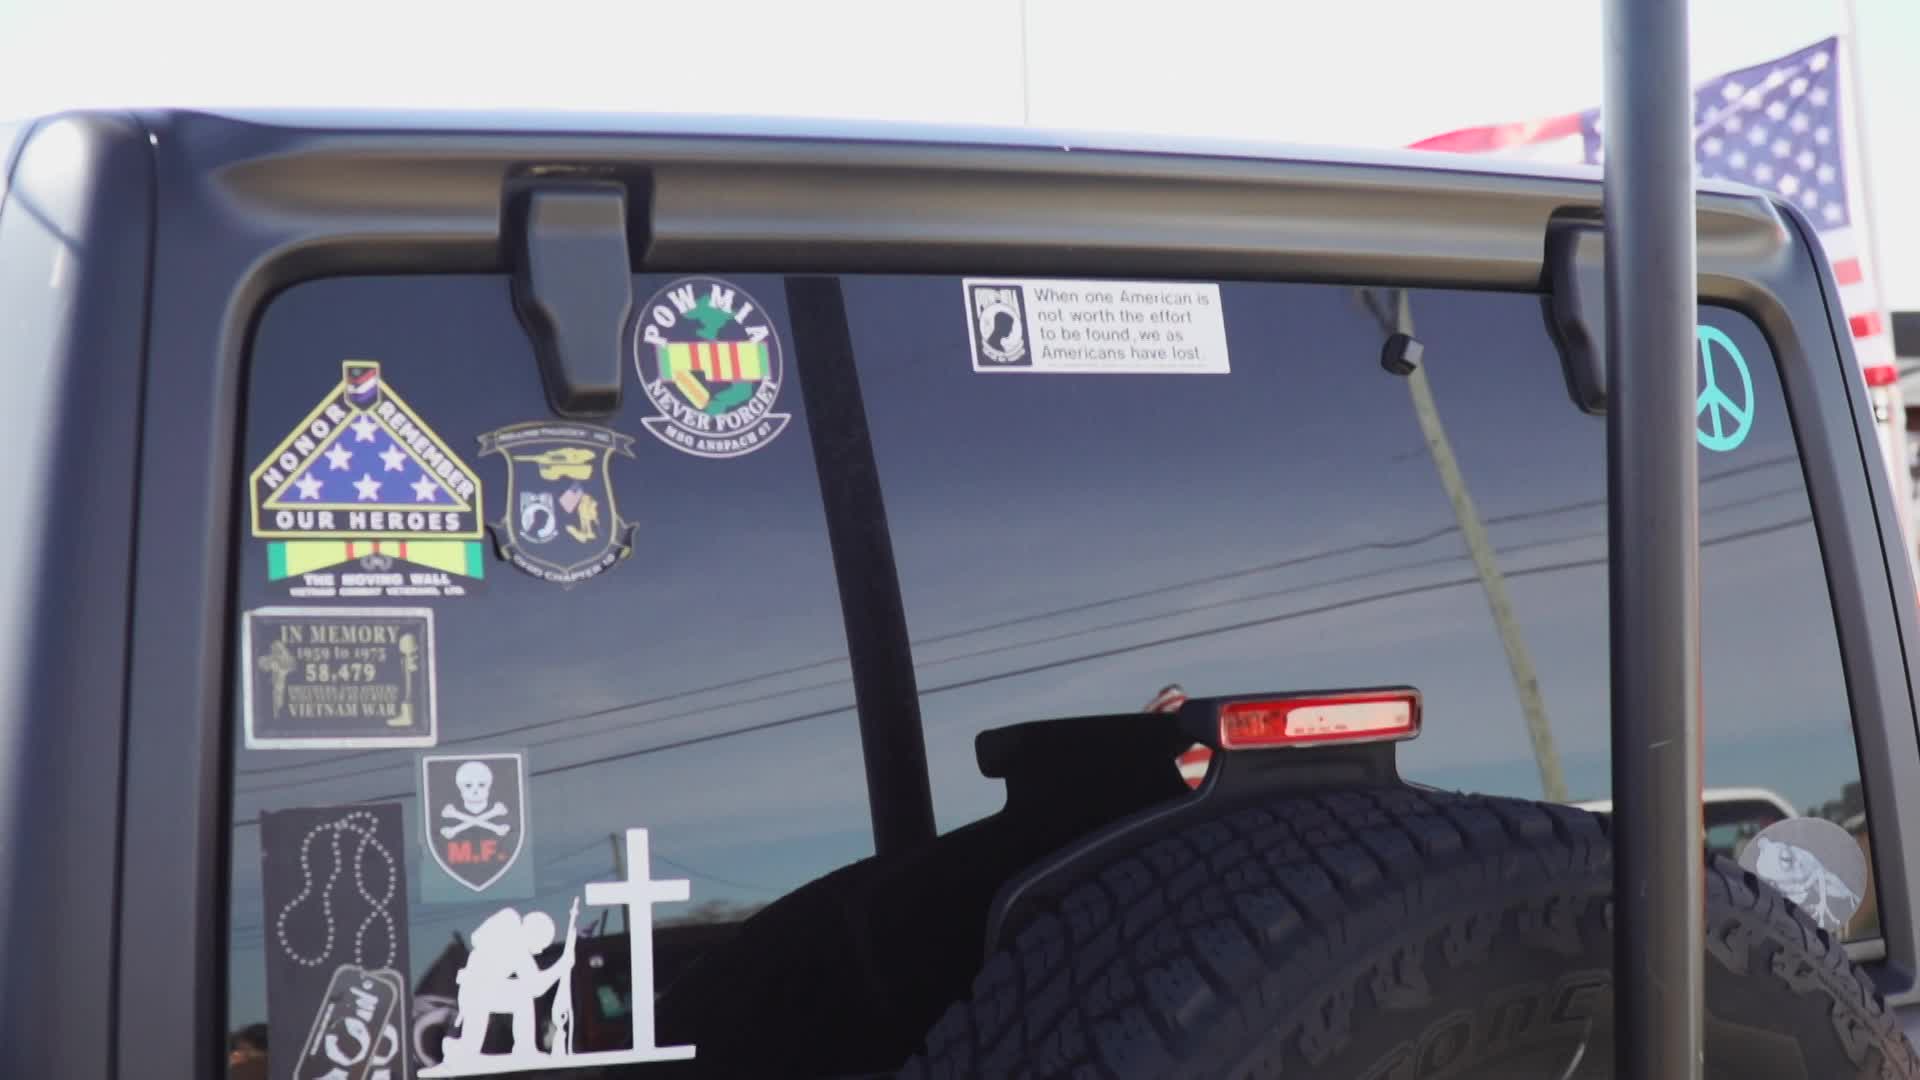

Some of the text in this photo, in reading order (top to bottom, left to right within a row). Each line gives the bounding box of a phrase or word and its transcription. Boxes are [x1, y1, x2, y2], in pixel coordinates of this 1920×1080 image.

[1033, 287, 1210, 306] When one American is
[643, 283, 769, 348] POW MIA
[1038, 309, 1192, 324] not worth the effort
[1040, 327, 1056, 341] to
[1061, 327, 1081, 341] be
[1138, 329, 1160, 342] we
[1166, 329, 1184, 342] as
[1041, 345, 1126, 360] Americans
[1131, 345, 1167, 360] have
[649, 376, 778, 431] NEVER FORGET
[262, 400, 475, 500] HONOR REMEMBER
[275, 511, 461, 531] OUR HEROES
[303, 573, 452, 586] THE MOVING WALL
[280, 625, 400, 644] IN MEMORY
[334, 645, 350, 660] to
[288, 702, 398, 719] VIETNAM WAR
[448, 839, 508, 865] M.F.
